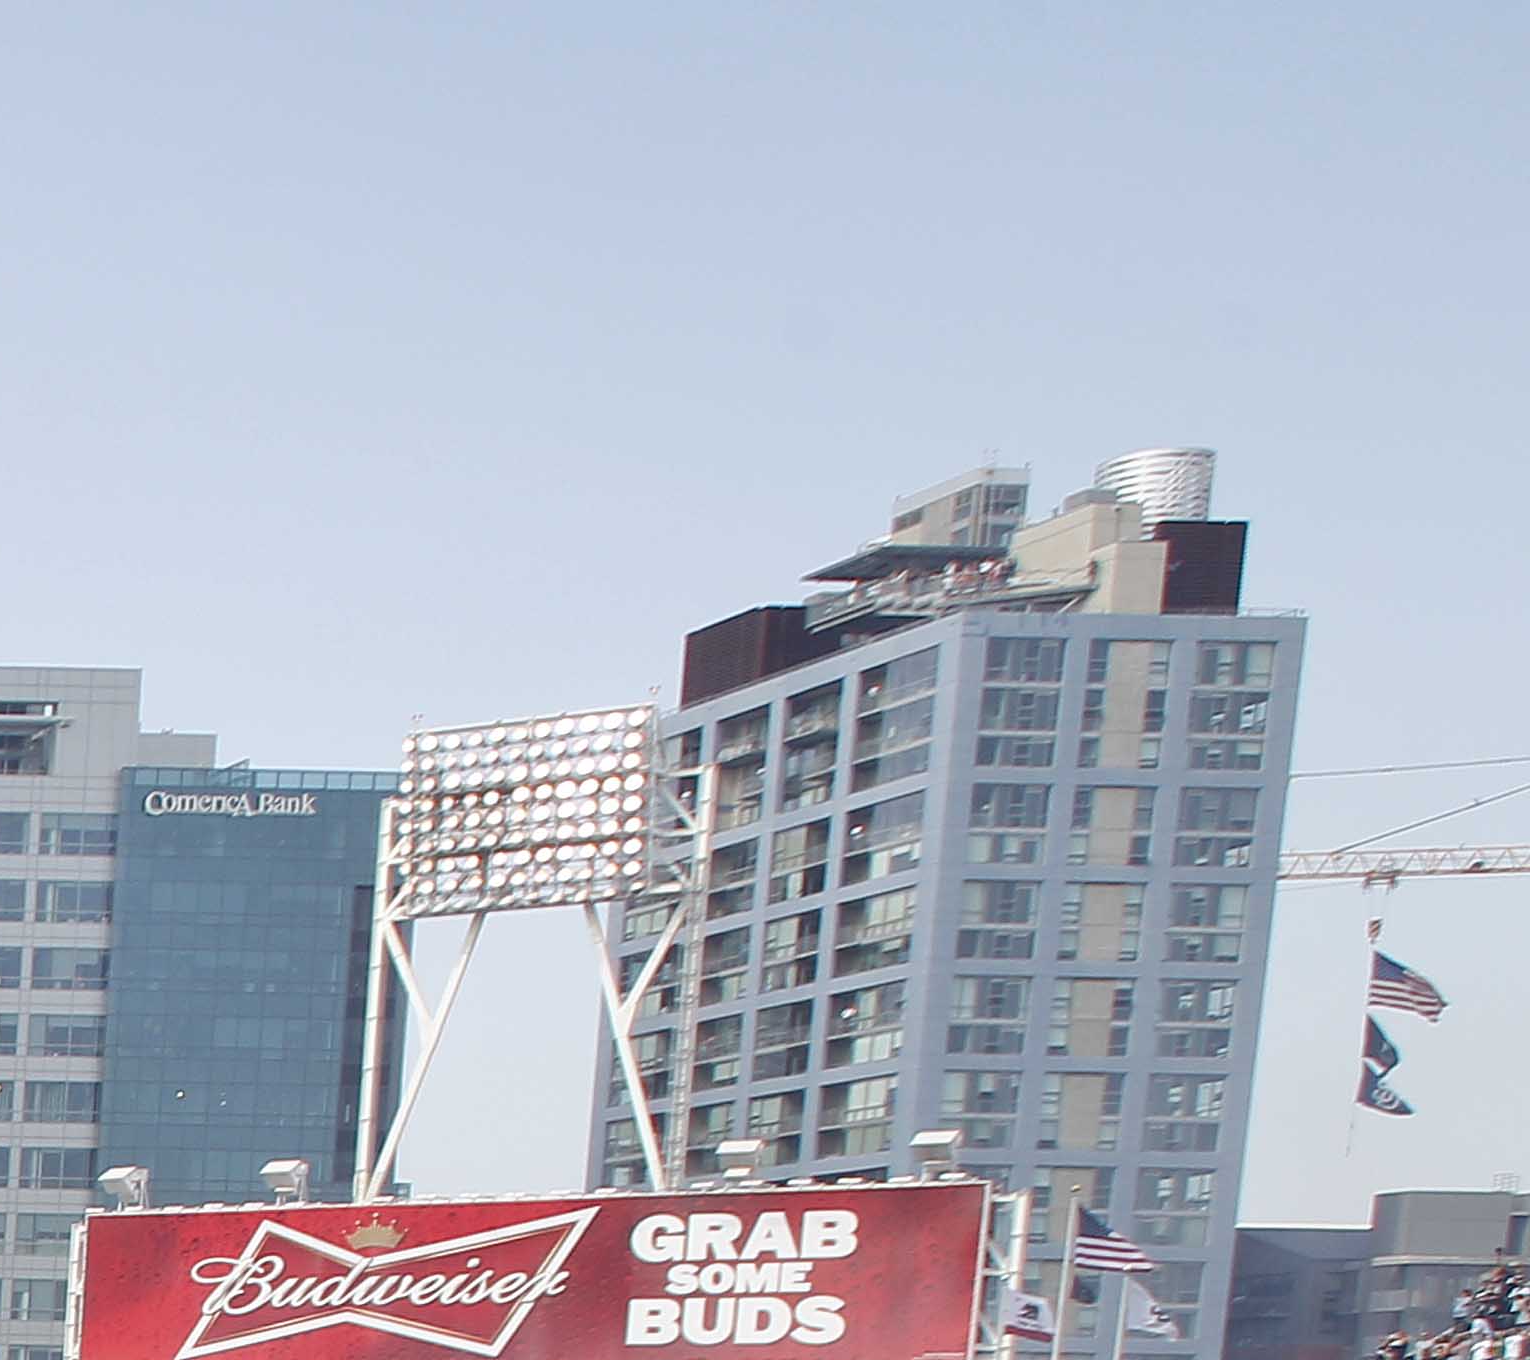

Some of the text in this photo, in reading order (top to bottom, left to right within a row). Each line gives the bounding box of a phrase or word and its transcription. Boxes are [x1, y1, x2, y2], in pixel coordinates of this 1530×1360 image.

[260, 793, 317, 814] Bank
[629, 1209, 858, 1263] GRAB
[191, 1257, 569, 1317] Budweiser
[664, 1261, 812, 1294] SOME
[624, 1295, 846, 1345] BUDS
